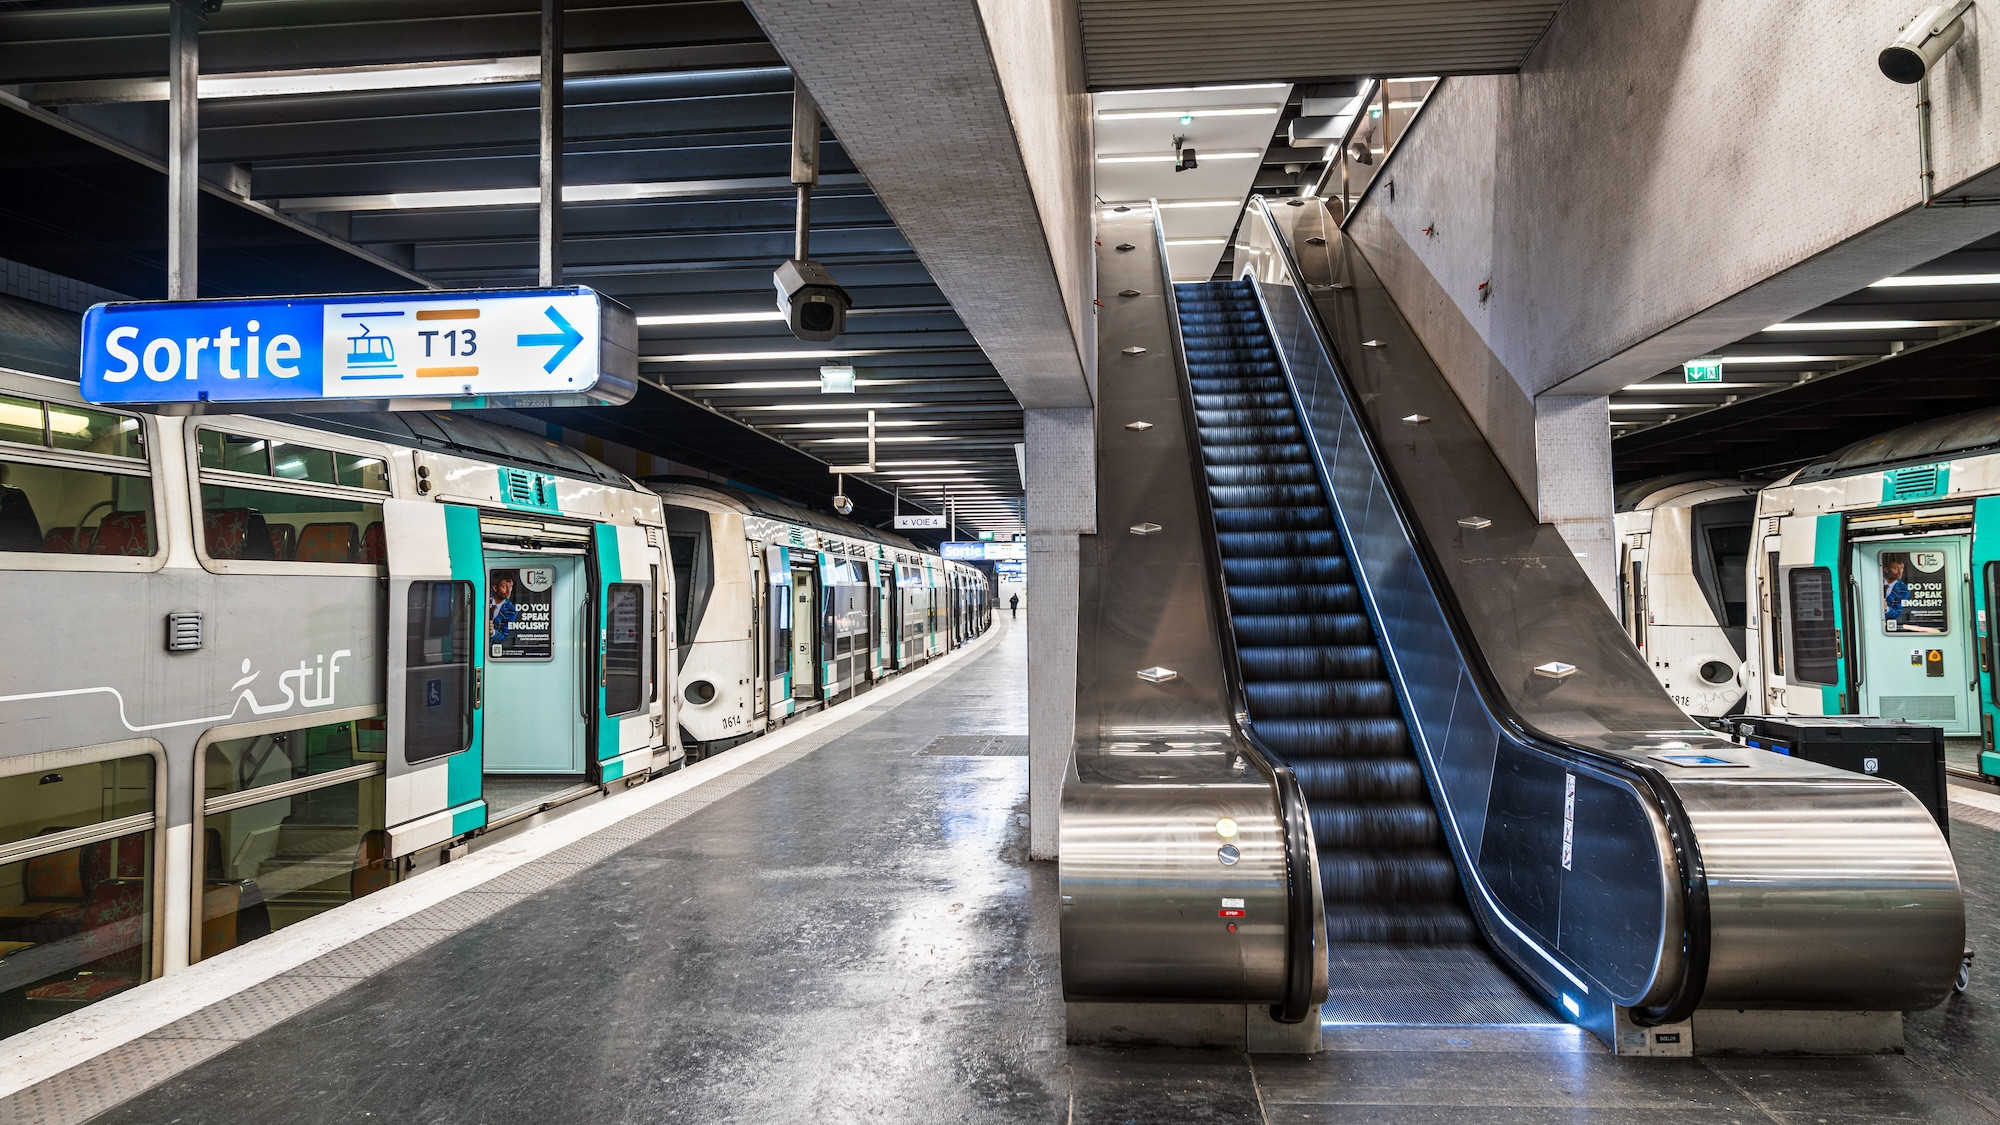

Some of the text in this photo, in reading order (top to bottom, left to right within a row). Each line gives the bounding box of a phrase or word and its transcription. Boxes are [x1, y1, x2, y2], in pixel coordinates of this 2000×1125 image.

[103, 320, 300, 382] Sortie
[418, 328, 477, 357] T13
[945, 545, 981, 557] Sortie
[1901, 599, 1942, 607] ENGLISH?
[508, 622, 549, 630] ENGLISH?
[279, 649, 351, 712] stif
